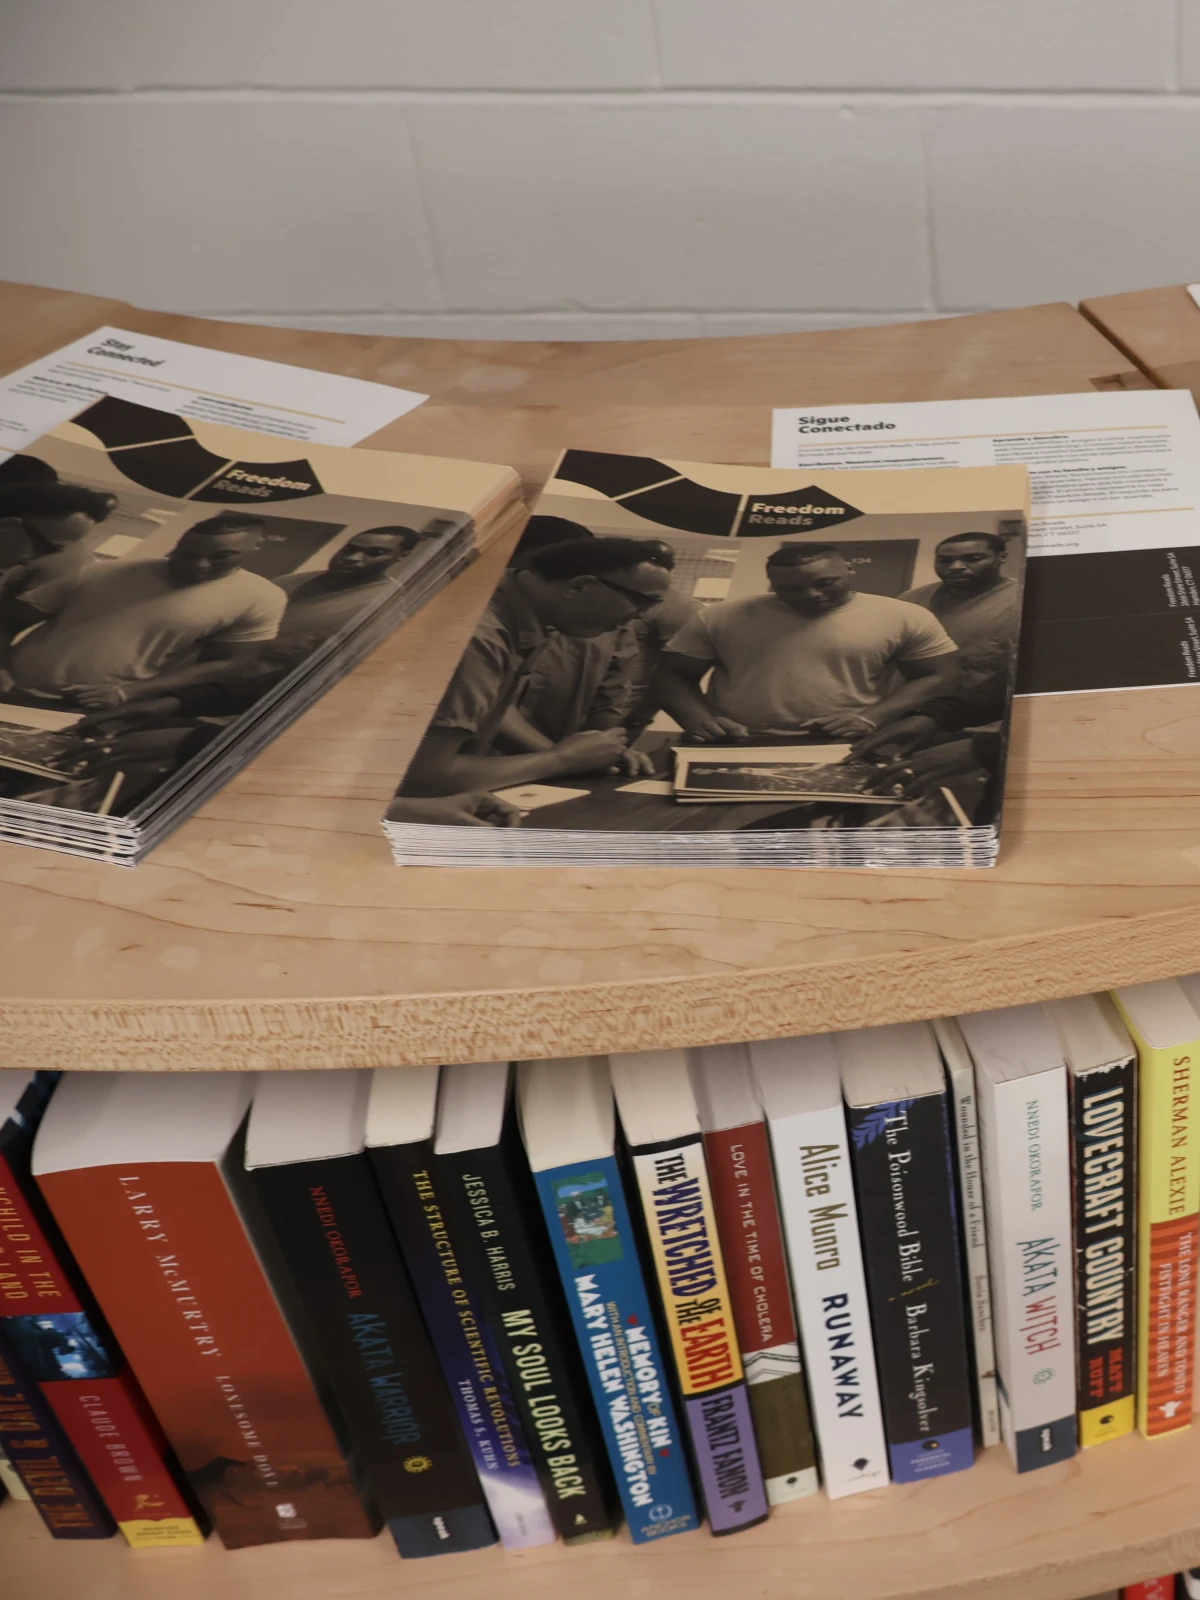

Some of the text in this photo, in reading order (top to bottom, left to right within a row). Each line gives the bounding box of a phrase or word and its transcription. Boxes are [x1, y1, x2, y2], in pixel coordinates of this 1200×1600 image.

[86, 346, 166, 367] Connected
[101, 338, 136, 351] Stay
[798, 416, 851, 426] Sigue
[798, 422, 897, 434] Conectado
[212, 479, 274, 498] Reads
[226, 468, 312, 492] Freedom
[747, 513, 814, 526] Reads
[750, 502, 846, 515] Freedom
[960, 1096, 986, 1249] Wounded the House Friend
[1026, 1101, 1042, 1211] NNEDI OKORAFOR
[1169, 1056, 1190, 1215] SHERMAN ALEXIE
[413, 1170, 433, 1200] THE
[652, 1152, 718, 1297] THE WRETCHED
[800, 1144, 848, 1271] Alice Munro
[883, 1110, 923, 1282] The Poisonwood Bible
[1083, 1086, 1125, 1344] LOVECRAFT COUNTRY
[15, 1250, 62, 1298] IN THE
[119, 1176, 221, 1357] LARRY McMURTRY
[309, 1186, 364, 1299] NNEDI OKORAFOR
[424, 1204, 463, 1285] STRUCTURE
[462, 1173, 516, 1291] JESSICA B. HARRIS
[730, 1144, 773, 1343] LOVE IN THE TIME OF CHOLERA
[452, 1281, 467, 1306] OF
[704, 1297, 722, 1316] OF
[906, 1303, 928, 1360] Barbara
[1017, 1237, 1061, 1356] AKATA WITCH
[1157, 1263, 1173, 1378] FISTFIGHT IN HEAVEN
[1173, 1231, 1193, 1394] THE LONE RANGER AND TONTO
[347, 1313, 421, 1445] AKATA WARRIOR
[458, 1310, 494, 1382] SCIENTIFIC
[626, 1325, 663, 1404] MEMORY
[647, 1416, 672, 1448] KIN
[675, 1299, 734, 1389] THE EARTH
[823, 1292, 863, 1419] RUNAWAY
[1088, 1357, 1104, 1398] RUFF
[1108, 1347, 1124, 1392] MATT
[216, 1375, 262, 1448] LONESOME
[458, 1379, 498, 1470] THOMAS KUHN
[484, 1386, 521, 1468] REVOLUTIONS
[501, 1309, 586, 1499] MY SOUL LOOKS BACK
[574, 1274, 653, 1507] MARY HELEN WASHINGTON
[909, 1363, 939, 1432] Kingsolver
[79, 1394, 143, 1481] CLAUDE BROWN
[702, 1393, 751, 1498] FRANTZ FANON
